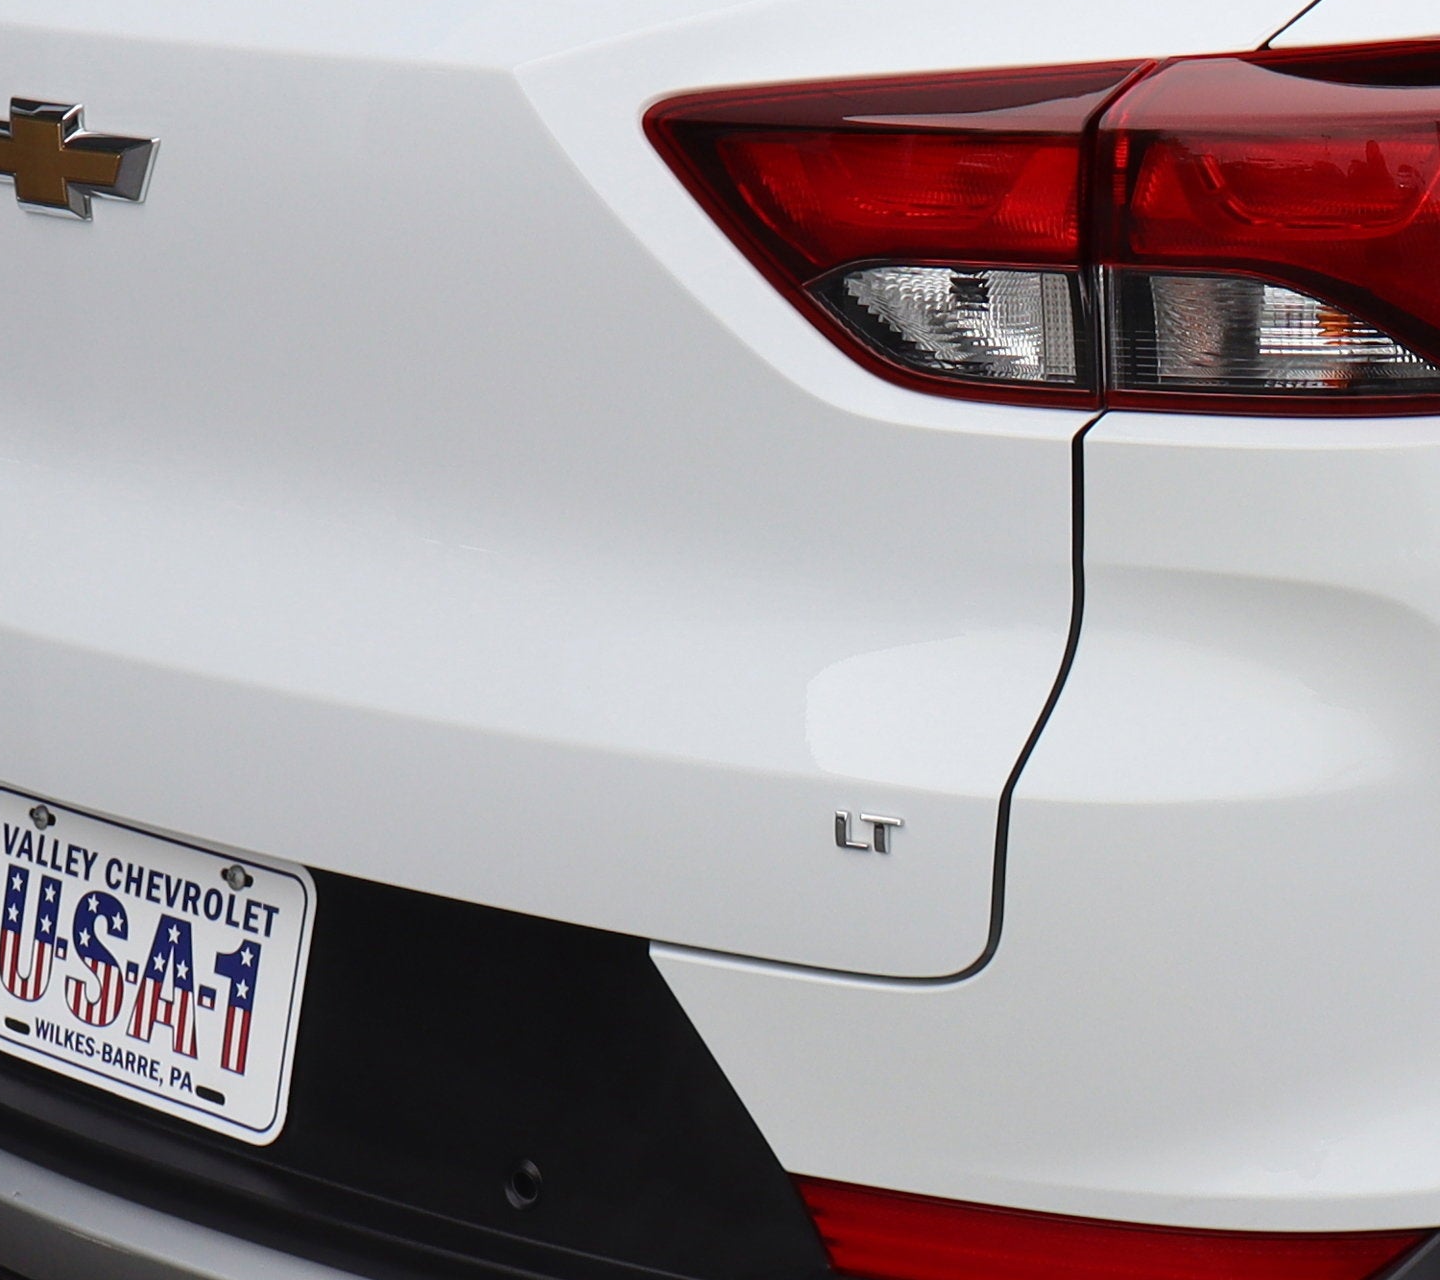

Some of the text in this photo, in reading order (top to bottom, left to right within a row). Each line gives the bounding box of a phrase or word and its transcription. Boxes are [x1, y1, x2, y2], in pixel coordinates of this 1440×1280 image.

[835, 810, 905, 854] LT
[3, 823, 280, 938] VALLEY CHEVROLET
[35, 1017, 194, 1094] WILKES-BARRE, PA
